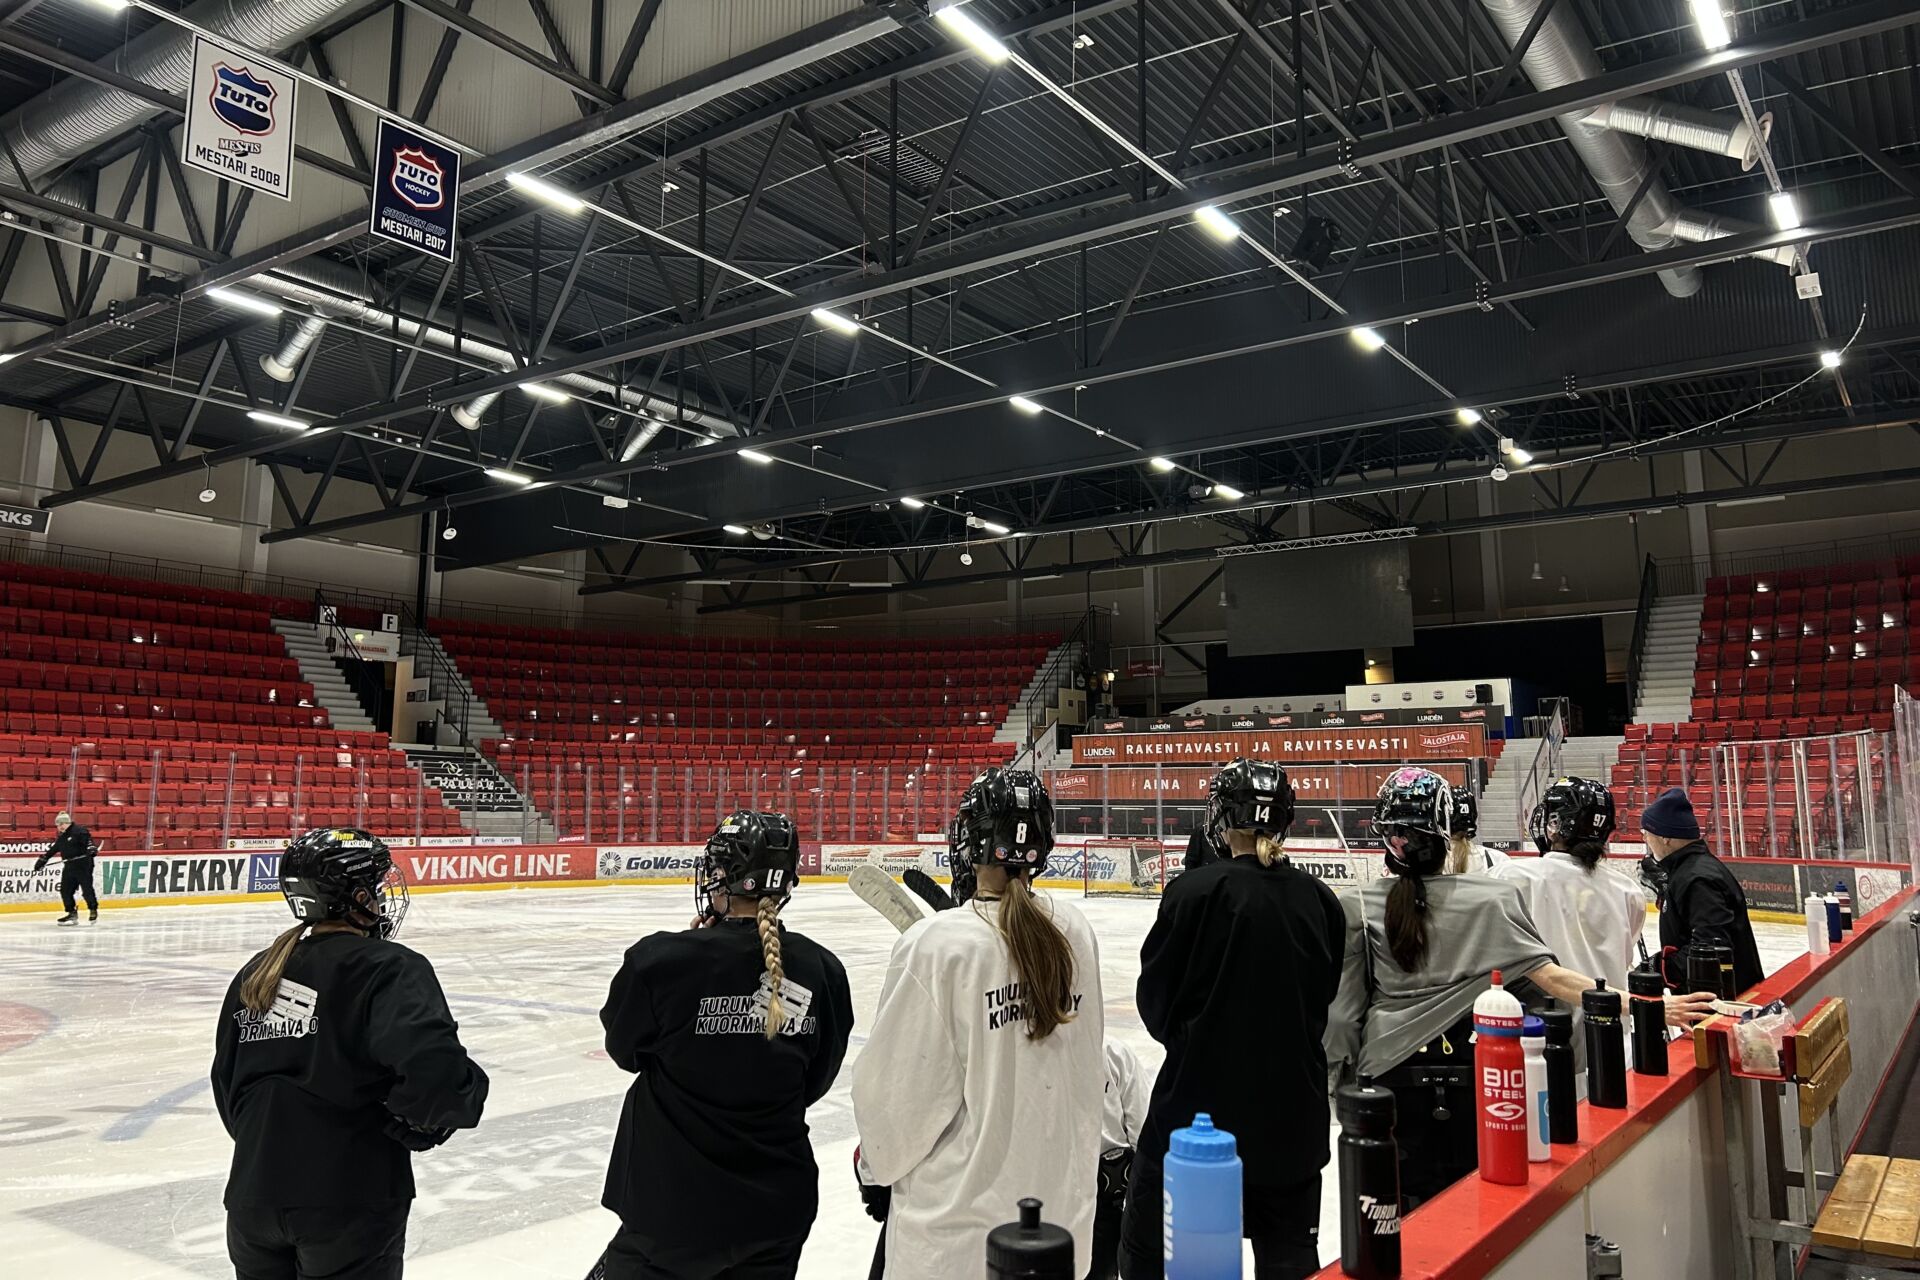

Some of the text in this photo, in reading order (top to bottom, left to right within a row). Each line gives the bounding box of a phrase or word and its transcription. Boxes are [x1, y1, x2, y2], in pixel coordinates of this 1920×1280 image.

[218, 137, 261, 156] MESTIS
[195, 144, 281, 187] MESTARI 2008
[398, 161, 439, 187] TUTO
[404, 182, 431, 198] HOCKEY
[382, 206, 425, 230] SUOMEN
[381, 216, 447, 252] MESTARI 2017
[386, 615, 394, 630] F
[1126, 738, 1408, 755] RAKENTAVASTI JA RAVITSEVASTI
[1423, 733, 1466, 745] JALOSTAJA
[1082, 744, 1116, 757] LUNDÉN
[1143, 778, 1181, 791] AINA
[1254, 805, 1270, 823] 14
[1458, 803, 1470, 814] 20
[1592, 813, 1607, 828] 97
[1015, 822, 1028, 844] 8
[0, 842, 55, 852] DWORK
[410, 853, 572, 881] VIKING LINE
[1078, 861, 1117, 872] SAMULI
[1099, 870, 1115, 880] OY
[102, 858, 246, 895] WEREKRY
[765, 868, 784, 888] 19
[293, 898, 308, 917] 15
[698, 996, 752, 1016] TURUN
[695, 1015, 796, 1035] KUORMALVA
[1478, 1016, 1518, 1027] BIOSTEEL
[1483, 1066, 1525, 1089] BIO
[1484, 1087, 1525, 1100] STEEL
[1485, 1120, 1509, 1132] SPORTS
